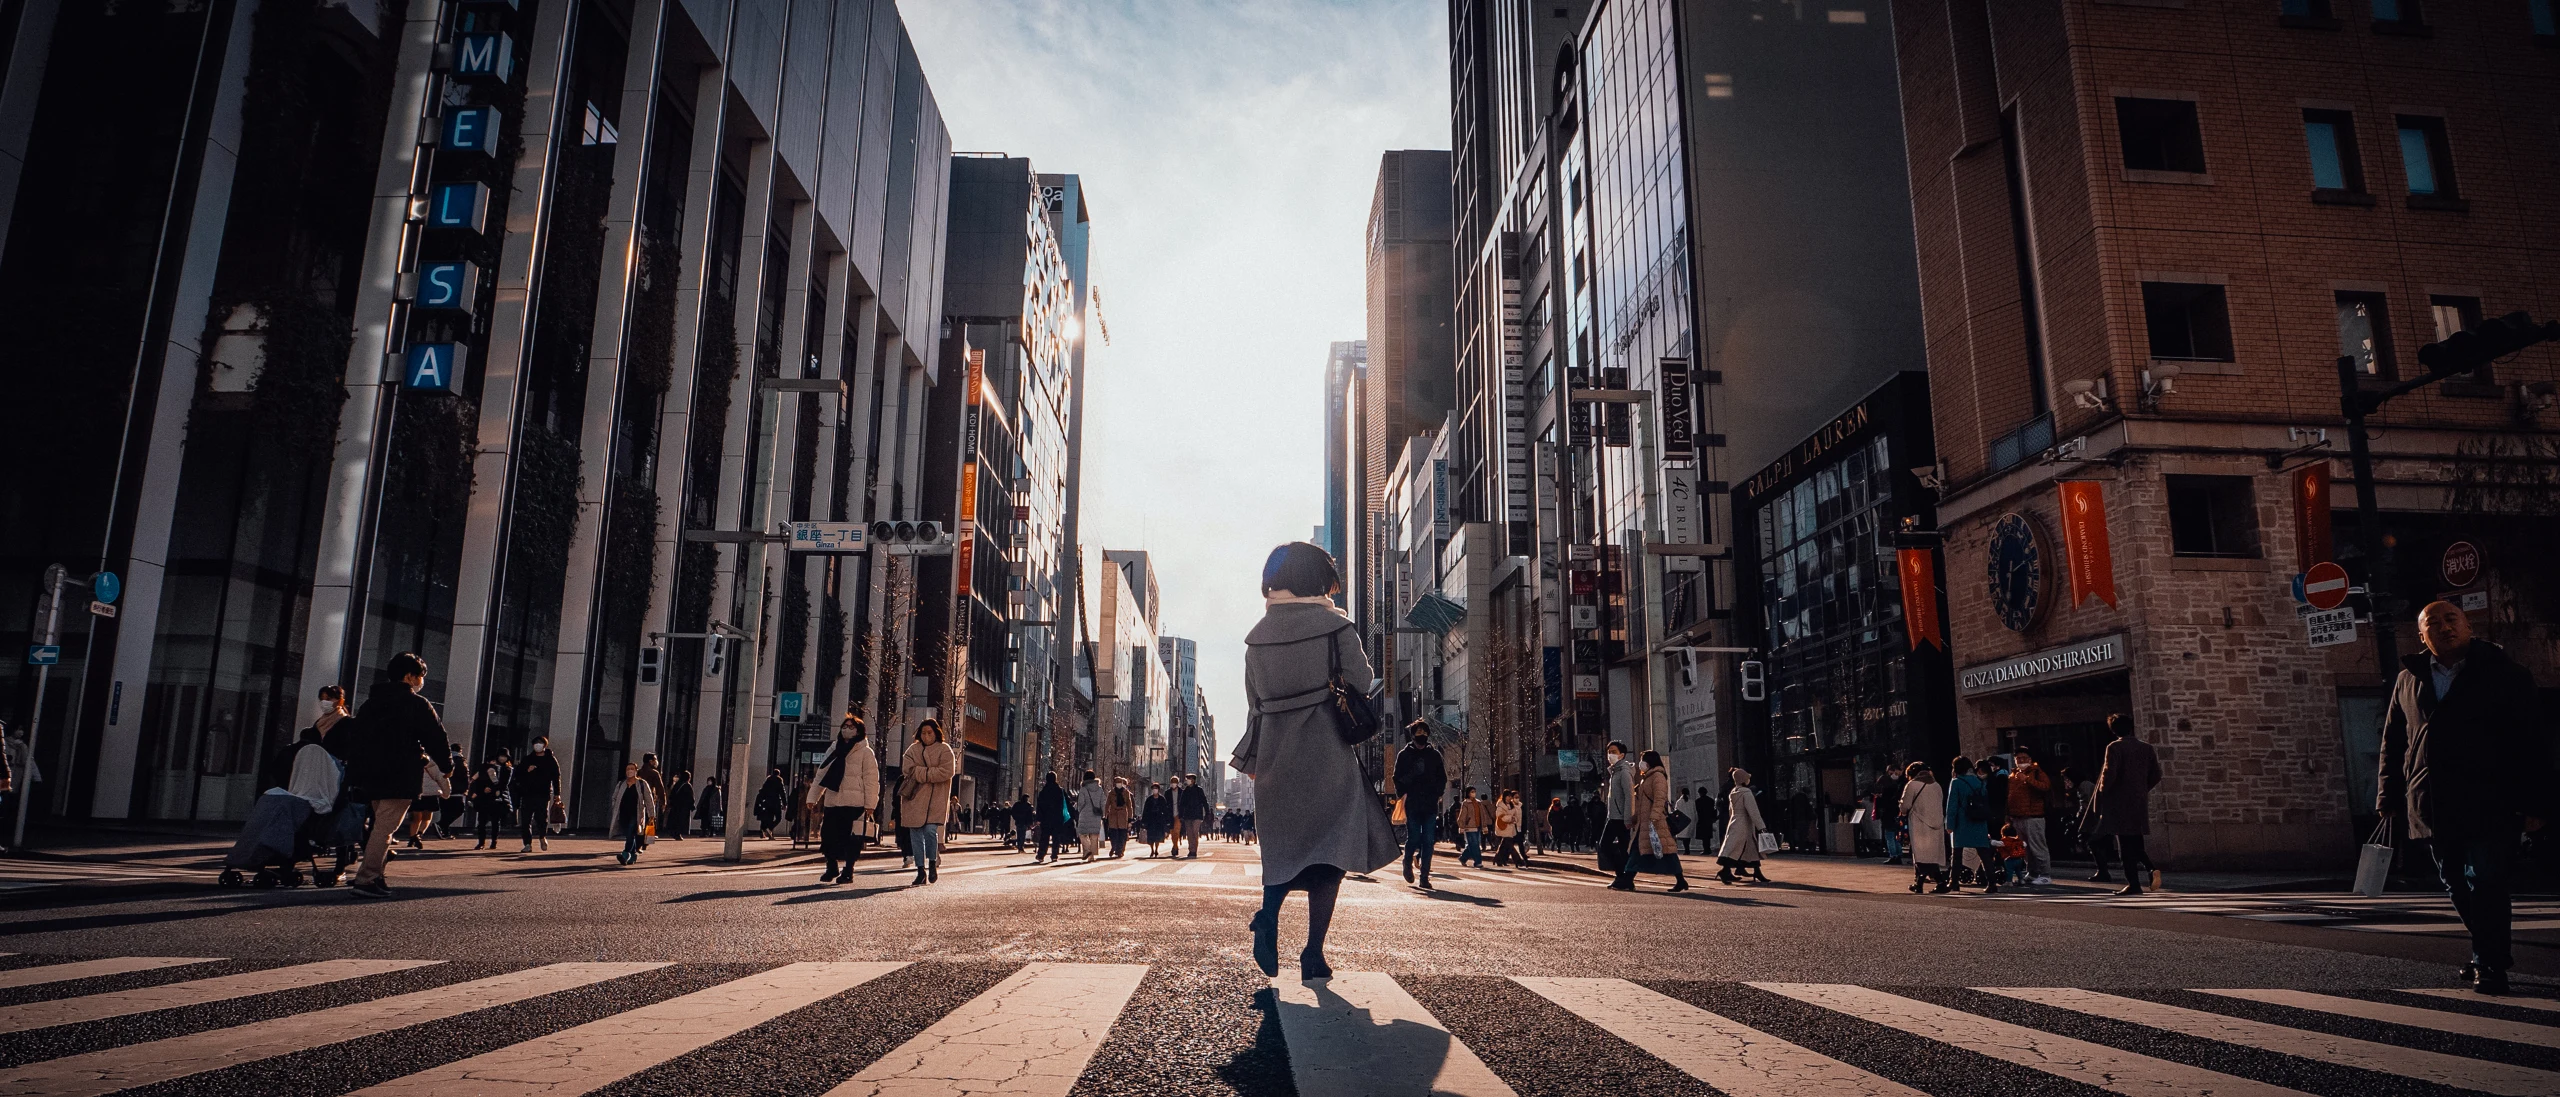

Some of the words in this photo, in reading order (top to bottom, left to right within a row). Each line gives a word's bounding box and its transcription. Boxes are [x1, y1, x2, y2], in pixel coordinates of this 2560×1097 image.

[413, 36, 495, 387] MELSA
[1670, 372, 1687, 407] Duo
[1672, 408, 1691, 444] Veel
[1748, 453, 1793, 499] RALPH
[1803, 402, 1868, 464] LAUREN
[796, 529, 862, 541] 銀座一丁目
[1675, 505, 1688, 565] BRIDL
[2446, 553, 2476, 575] 消火栓
[2309, 611, 2352, 625] 自転車を除く
[2311, 633, 2340, 645] 時間を除く
[1963, 670, 1996, 689] GINZA
[1996, 657, 2051, 682] DIAMOND
[2051, 643, 2114, 671] SHIRAISHI
